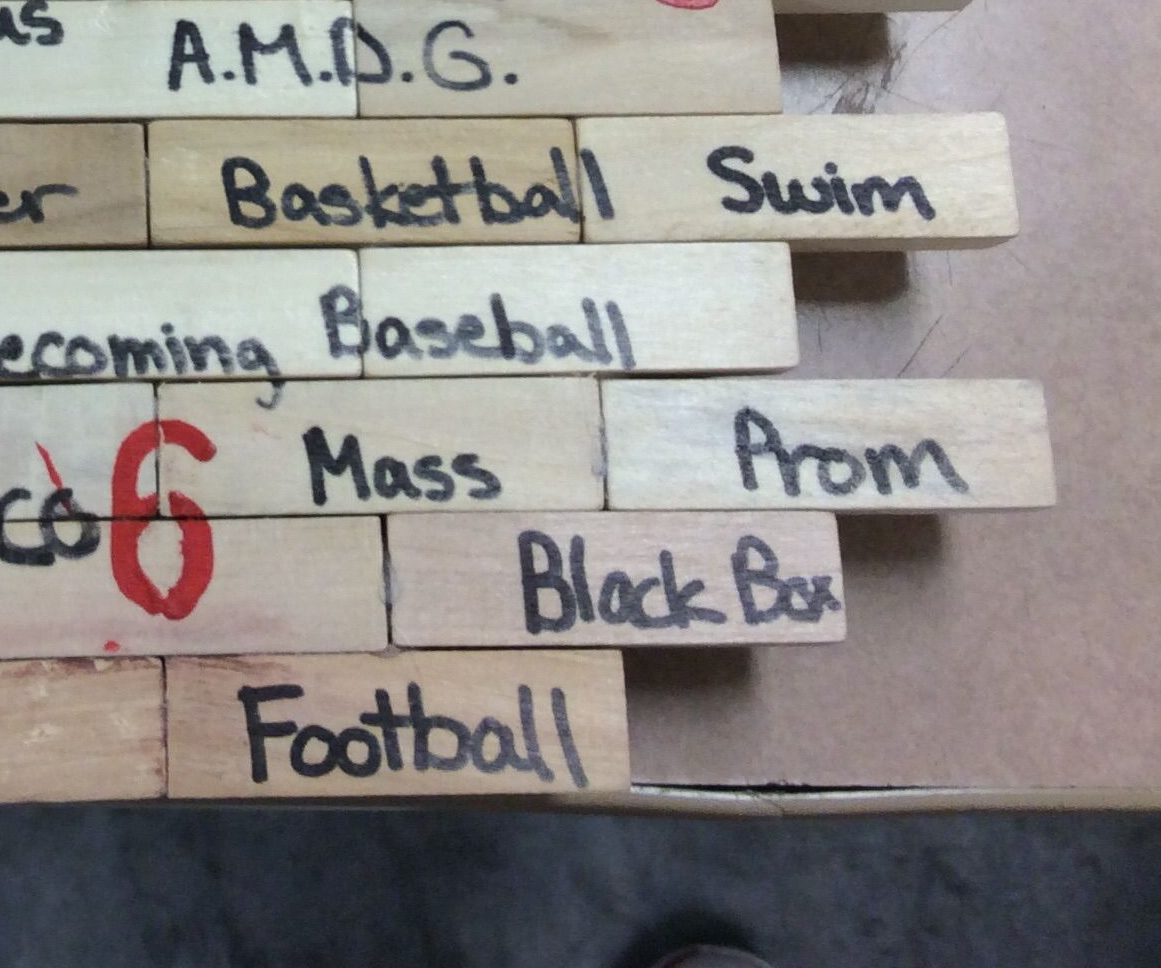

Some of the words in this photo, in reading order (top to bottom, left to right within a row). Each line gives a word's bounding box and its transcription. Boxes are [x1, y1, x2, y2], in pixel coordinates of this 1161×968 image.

[167, 19, 519, 92] A.M.D.G.
[221, 147, 615, 230] Basketball
[706, 145, 937, 222] Swim
[320, 284, 636, 372] Baseball
[303, 426, 502, 507] Mass
[734, 406, 970, 496] Prom
[109, 419, 217, 621] 6
[518, 530, 727, 635] Black
[734, 534, 843, 624] Box
[238, 679, 590, 788] Football
